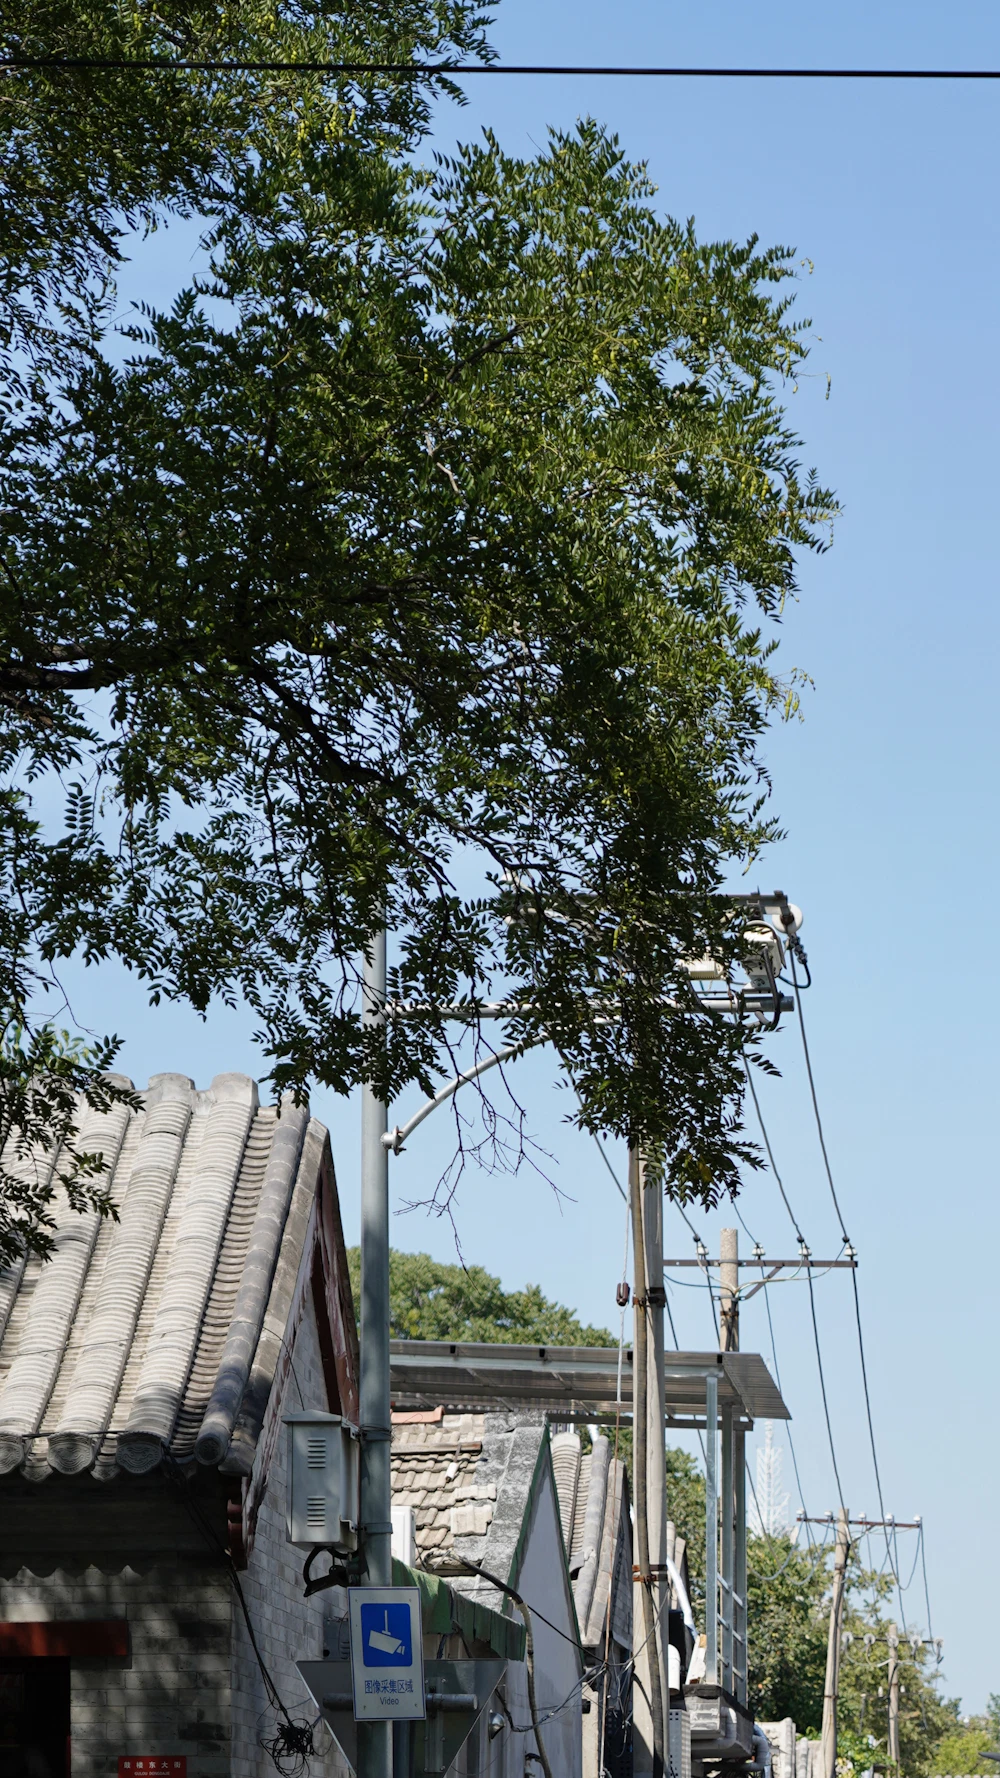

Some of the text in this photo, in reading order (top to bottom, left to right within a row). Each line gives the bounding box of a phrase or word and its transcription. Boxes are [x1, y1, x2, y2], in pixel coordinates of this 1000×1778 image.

[365, 1679, 413, 1693] 图像采集区域
[380, 1697, 399, 1705] Video
[124, 1761, 181, 1769] 鼓楼东大街
